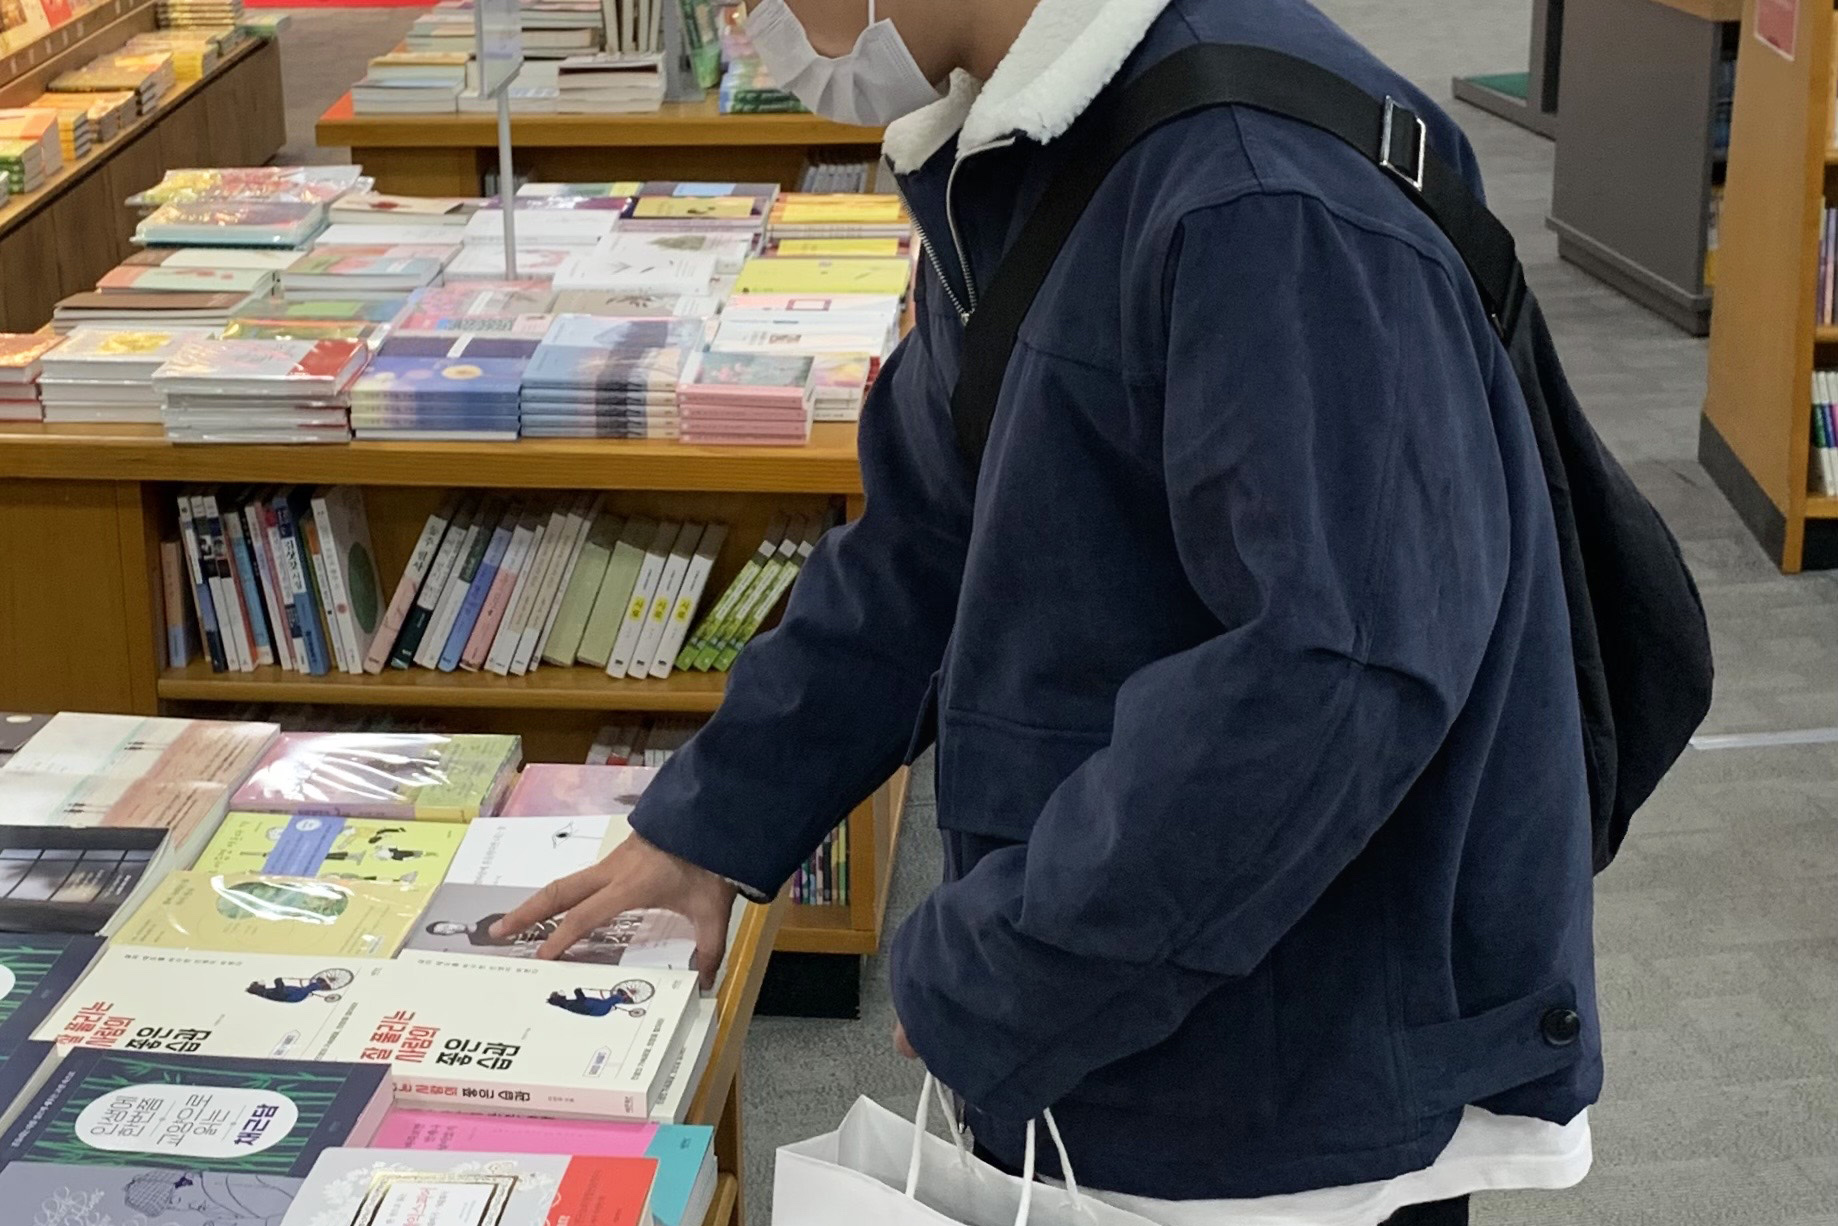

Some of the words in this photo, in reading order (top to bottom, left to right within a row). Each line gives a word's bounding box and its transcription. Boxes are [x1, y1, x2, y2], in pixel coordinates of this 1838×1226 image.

[61, 1000, 115, 1032] 풀리는
[83, 1016, 135, 1047] 사람의
[368, 1008, 416, 1044] 풀리는
[124, 1025, 174, 1051] 좋은
[163, 1028, 213, 1053] 습관
[393, 1025, 441, 1063] 사람의
[434, 1037, 482, 1067] 좋은
[359, 1046, 394, 1062] 잘
[474, 1041, 522, 1071] 습관
[90, 1094, 134, 1136] 인생에
[156, 1094, 213, 1146] 교양으로
[193, 1108, 231, 1136] 읽는
[233, 1104, 280, 1145] 채근담
